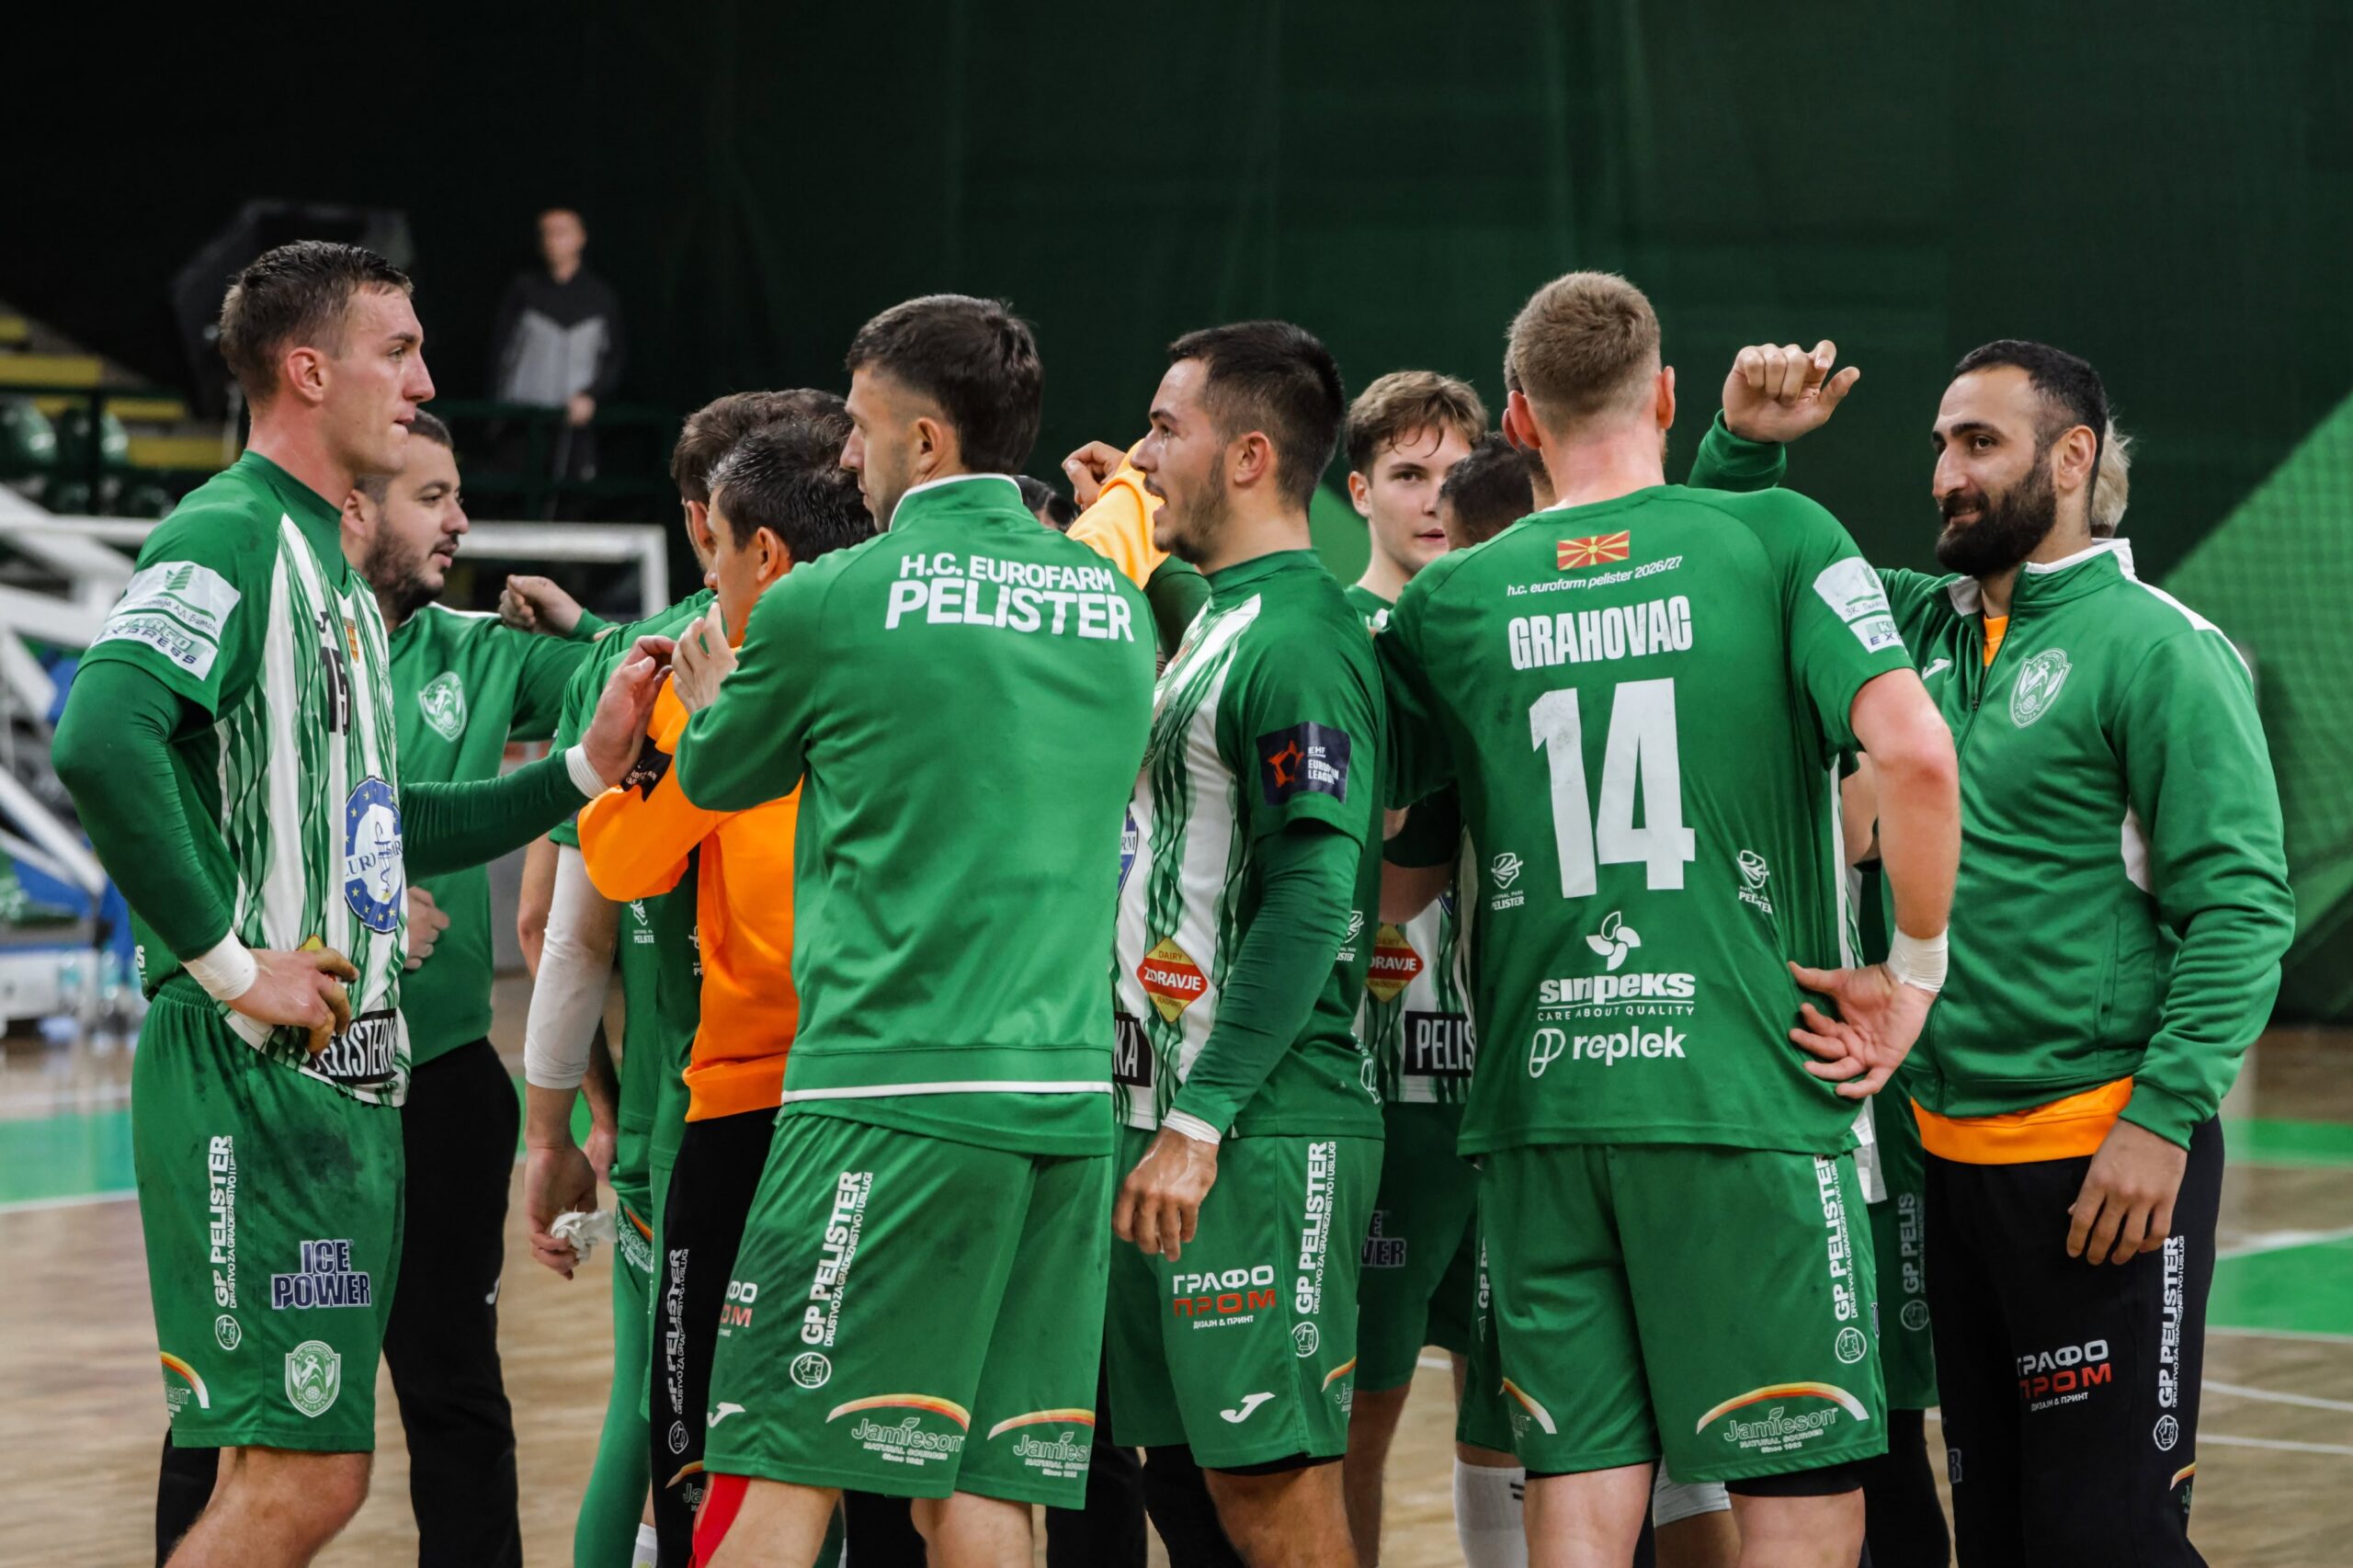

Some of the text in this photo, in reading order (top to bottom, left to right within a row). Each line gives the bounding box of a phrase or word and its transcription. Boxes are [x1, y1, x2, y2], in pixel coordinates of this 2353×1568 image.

[899, 552, 1117, 593] H.C. EUROFARM
[1506, 556, 1683, 597] h.c. eurofarm pelister 2026/27
[884, 577, 1136, 642] PELISTER
[96, 628, 198, 665] PRESS
[1508, 596, 1693, 670] GRAHOVAC
[321, 646, 352, 736] 15
[1529, 677, 1696, 899] 14
[346, 851, 376, 877] URO
[1158, 950, 1183, 960] DAIRY
[1336, 952, 1355, 961] ISTER
[1370, 956, 1417, 971] DRAVJE
[1144, 966, 1201, 991] ZDRAVJE
[1538, 1006, 1695, 1021] CARE ABOUT QUALITY
[1416, 1019, 1475, 1070] PELIS
[1573, 1026, 1687, 1066] replek
[1326, 1142, 1336, 1176] USLUGI
[856, 1172, 873, 1209] USLUGI
[208, 1135, 230, 1307] GP PELISTER
[1295, 1142, 1327, 1314] GP PELISTER
[227, 1248, 235, 1263] ZA
[300, 1239, 351, 1274] ICE
[801, 1172, 862, 1345] GP PELISTER
[1317, 1254, 1325, 1267] ZA
[1361, 1237, 1406, 1267] WER
[1898, 1193, 1919, 1294] GP PELIS
[271, 1272, 371, 1310] POWER
[832, 1287, 844, 1300] ZA
[1173, 1265, 1274, 1294] ГРАФО
[1313, 1268, 1323, 1314] DRUSTVO
[1478, 1274, 1490, 1309] GP
[666, 1249, 683, 1371] PELISTER
[1174, 1289, 1276, 1316] ПРОМ
[1833, 1283, 1850, 1321] GP
[824, 1300, 841, 1346] DRUSTVO
[1219, 1318, 1225, 1326] &
[1227, 1315, 1254, 1325] ПРИНТ
[2158, 1236, 2178, 1408] GP PELISTER
[2061, 1392, 2088, 1404] ПРИНТ
[851, 1418, 963, 1452] Jamieson
[1723, 1407, 1838, 1441] Jamieson
[1013, 1434, 1090, 1461] Jamies
